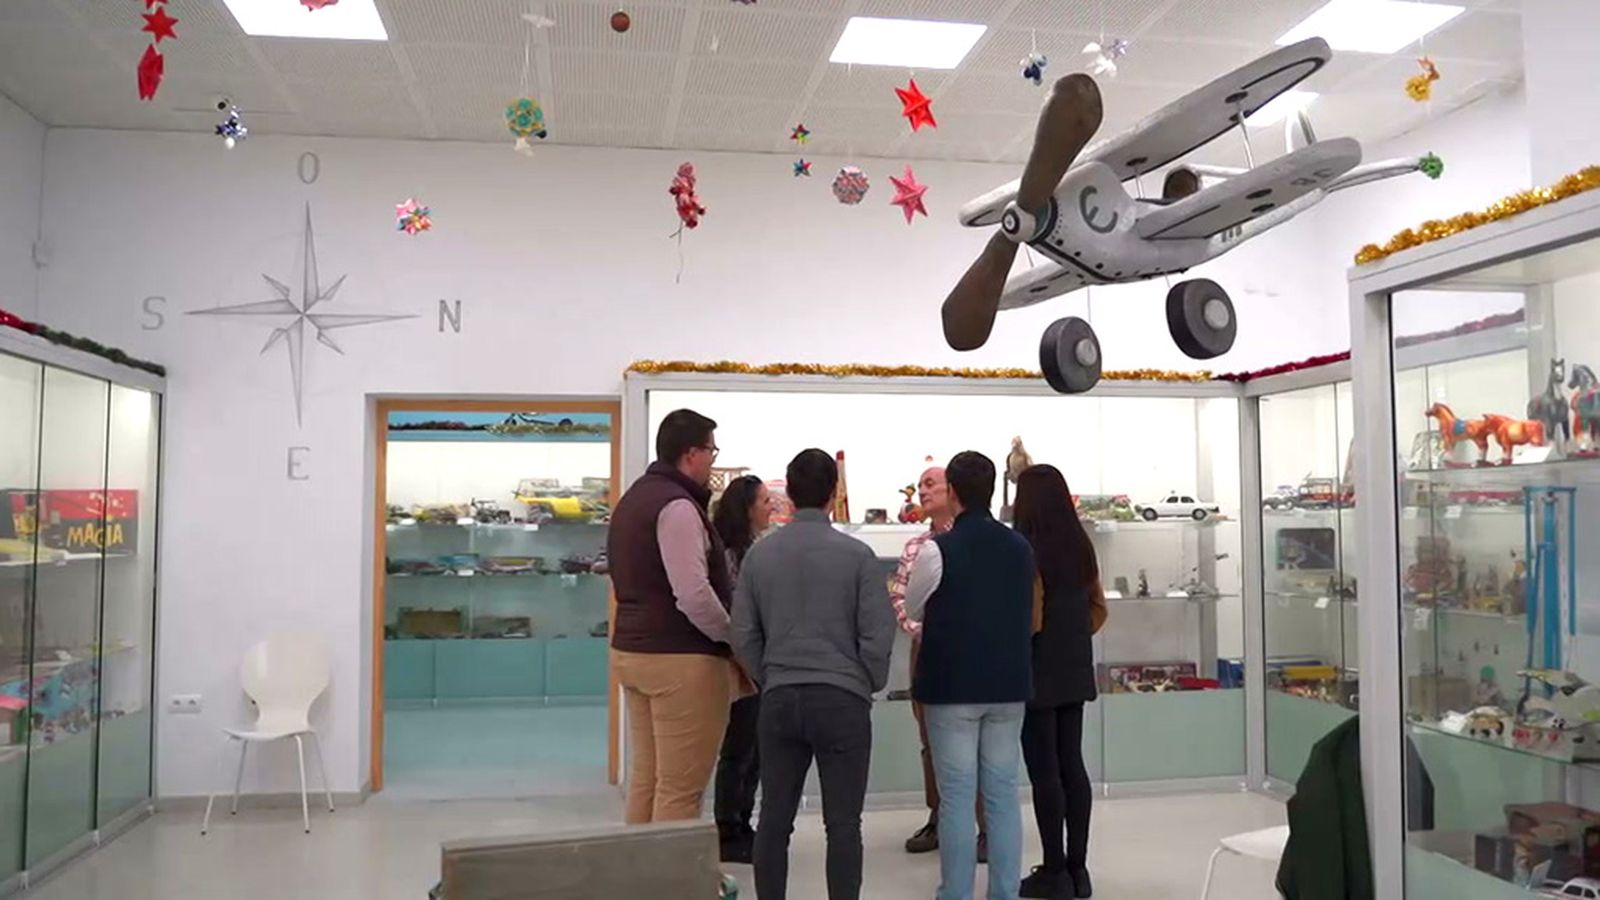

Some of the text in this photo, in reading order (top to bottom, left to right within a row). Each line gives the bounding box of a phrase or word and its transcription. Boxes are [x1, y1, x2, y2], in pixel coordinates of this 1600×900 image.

[141, 297, 167, 331] S
[438, 300, 462, 333] N
[287, 446, 310, 480] E
